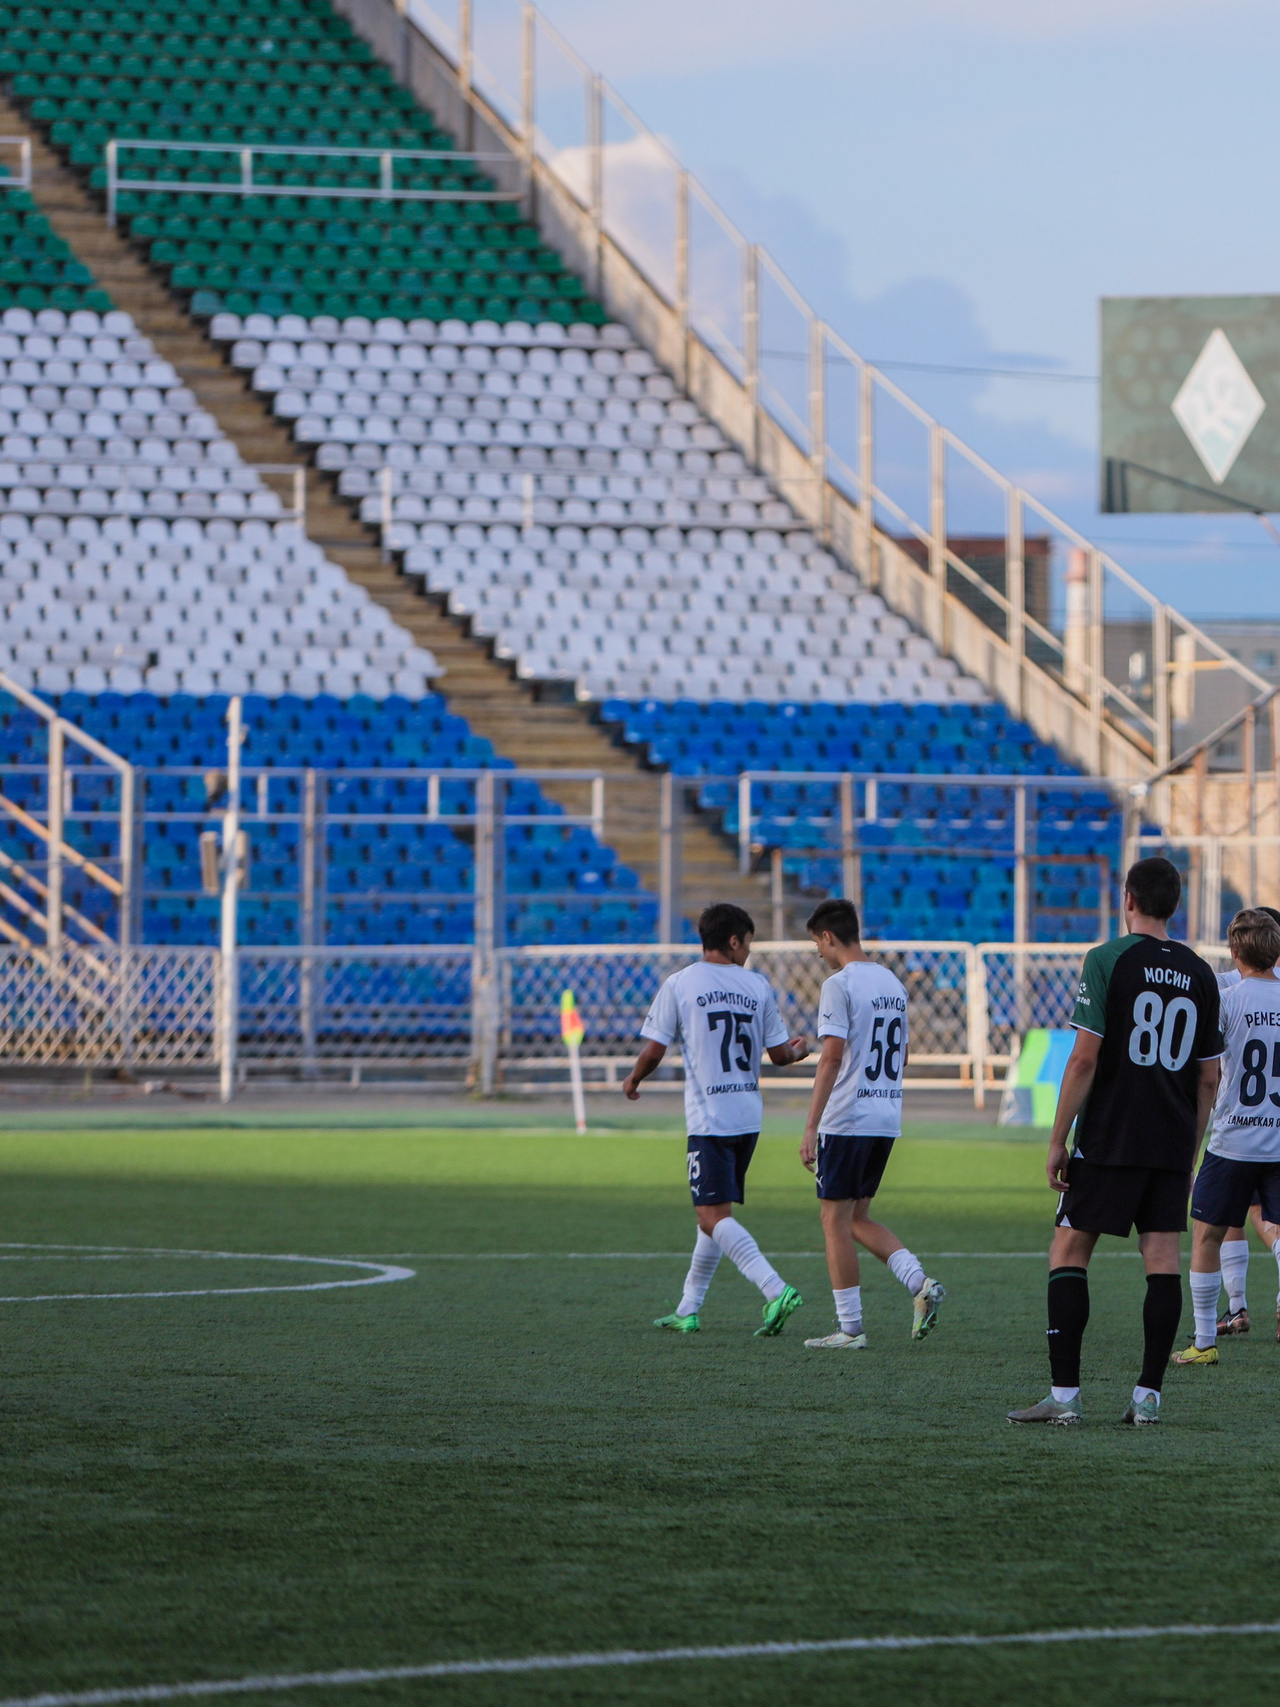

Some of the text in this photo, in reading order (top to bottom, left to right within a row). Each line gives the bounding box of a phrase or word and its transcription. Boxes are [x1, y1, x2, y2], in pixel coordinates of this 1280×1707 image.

[1143, 966, 1192, 991] МОСИН
[707, 1010, 754, 1073] 75
[864, 1016, 903, 1082] 58
[1128, 990, 1198, 1072] 80
[1228, 1115, 1274, 1128] САМАРСКАЯ
